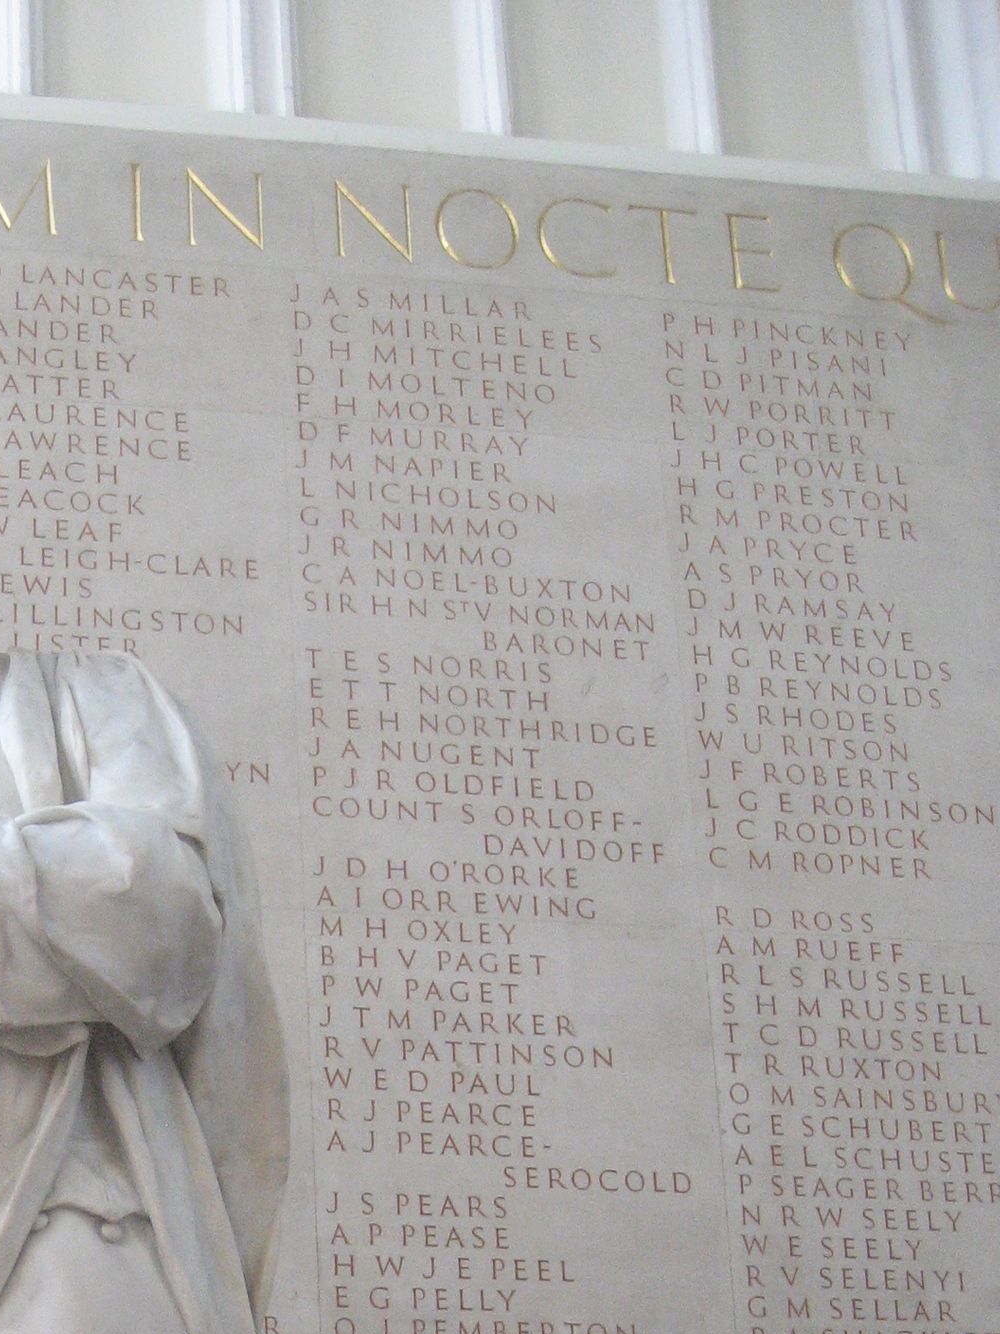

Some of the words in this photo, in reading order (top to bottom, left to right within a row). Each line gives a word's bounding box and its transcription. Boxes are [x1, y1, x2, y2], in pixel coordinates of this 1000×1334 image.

[129, 161, 266, 250] IN
[334, 177, 782, 294] NOCTE
[292, 308, 313, 332] D
[328, 312, 350, 335] C
[370, 316, 603, 354] MIRRIELEES
[660, 310, 676, 333] P
[693, 314, 715, 337] H
[732, 317, 912, 352] PINCKNEY
[294, 360, 316, 387] D
[338, 366, 346, 389] I
[367, 370, 557, 405] MOLTENO
[663, 365, 686, 388] C
[701, 368, 723, 391] D
[738, 371, 874, 403] PITMAN
[296, 419, 319, 442] D
[335, 418, 351, 444] F
[369, 426, 529, 457] MURRAY
[299, 475, 315, 499] L
[334, 478, 557, 515] NICHOLSON
[676, 475, 699, 498] H
[714, 479, 735, 501] G
[752, 481, 910, 514] PRESTON
[298, 504, 320, 528] G
[340, 507, 360, 531] R
[380, 511, 519, 541] NIMMO
[686, 587, 709, 611] D
[723, 590, 737, 613] J
[753, 592, 896, 624] RAMSAY
[307, 735, 322, 759] J
[339, 737, 362, 760] A
[379, 739, 541, 770] NUGENT
[696, 727, 724, 752] W
[742, 731, 763, 756] U
[780, 733, 910, 764] RITSON
[704, 814, 718, 839] J
[735, 817, 757, 841] C
[773, 819, 931, 852] RODDICK
[319, 914, 344, 938] M
[364, 916, 388, 940] H
[406, 918, 518, 946] OXLEY
[714, 904, 735, 928] R
[751, 906, 773, 930] D
[790, 908, 875, 935] ROSS
[320, 971, 338, 998] P
[353, 975, 384, 999] W
[404, 976, 520, 1006] PAGET
[322, 1034, 345, 1059] R
[360, 1036, 383, 1062] V
[399, 1037, 614, 1070] PATTINSON
[723, 1050, 743, 1075] T
[761, 1051, 785, 1077] R
[799, 1053, 943, 1083] RUXTON
[329, 1222, 353, 1247] A
[367, 1221, 384, 1247] P
[400, 1223, 510, 1251] PEASE
[740, 1233, 769, 1257] W
[786, 1234, 804, 1259] E
[819, 1235, 923, 1262] SEELY
[333, 1284, 351, 1310] E
[368, 1285, 391, 1311] G
[411, 1286, 517, 1313] PELLY
